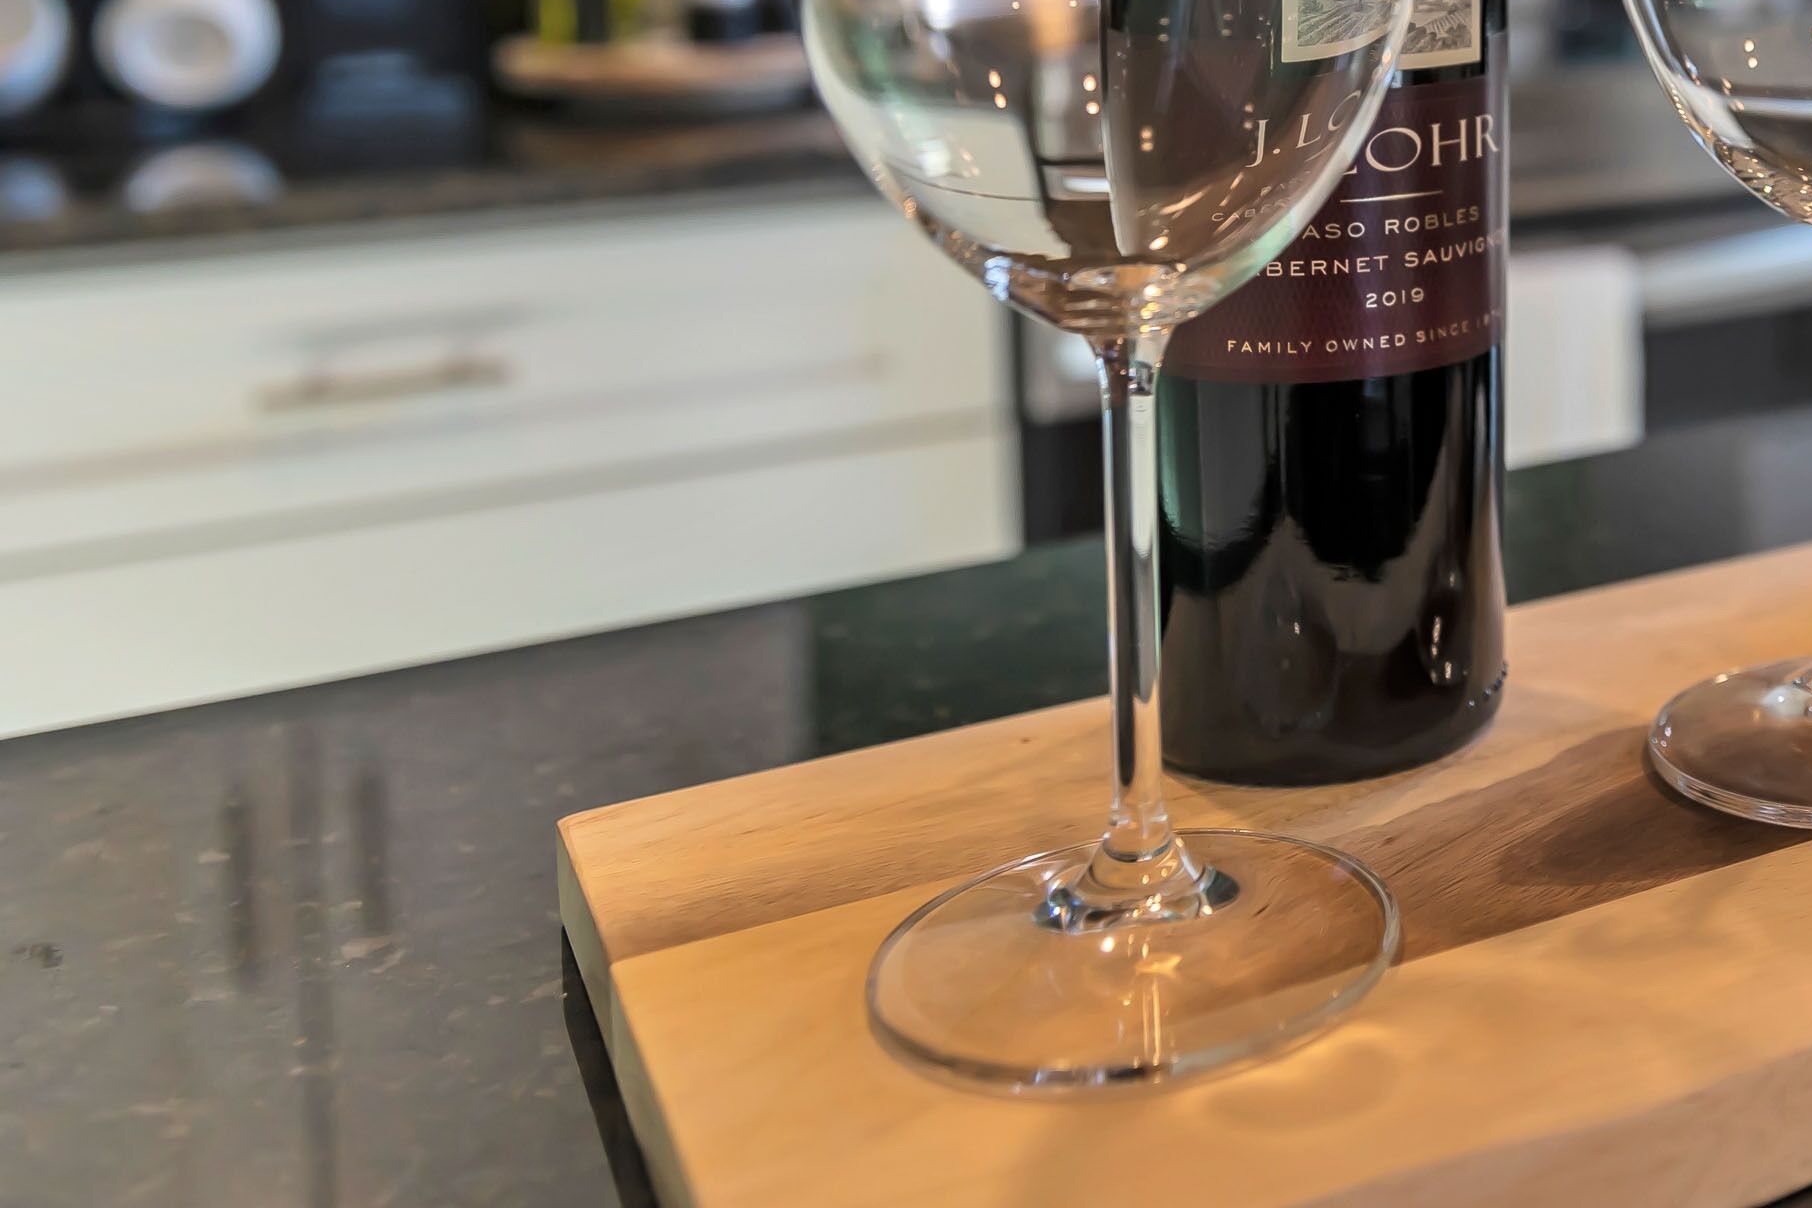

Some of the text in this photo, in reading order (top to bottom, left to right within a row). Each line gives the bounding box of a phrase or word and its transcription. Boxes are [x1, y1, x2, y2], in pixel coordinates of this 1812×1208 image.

[1343, 113, 1500, 176] OHR
[1302, 205, 1480, 240] ASO ROBLES
[1256, 254, 1389, 277] BERNET
[1365, 287, 1425, 309] 2019
[1226, 339, 1313, 354] FAMILY
[1325, 333, 1406, 353] OWNED
[1415, 319, 1470, 344] SINCE
